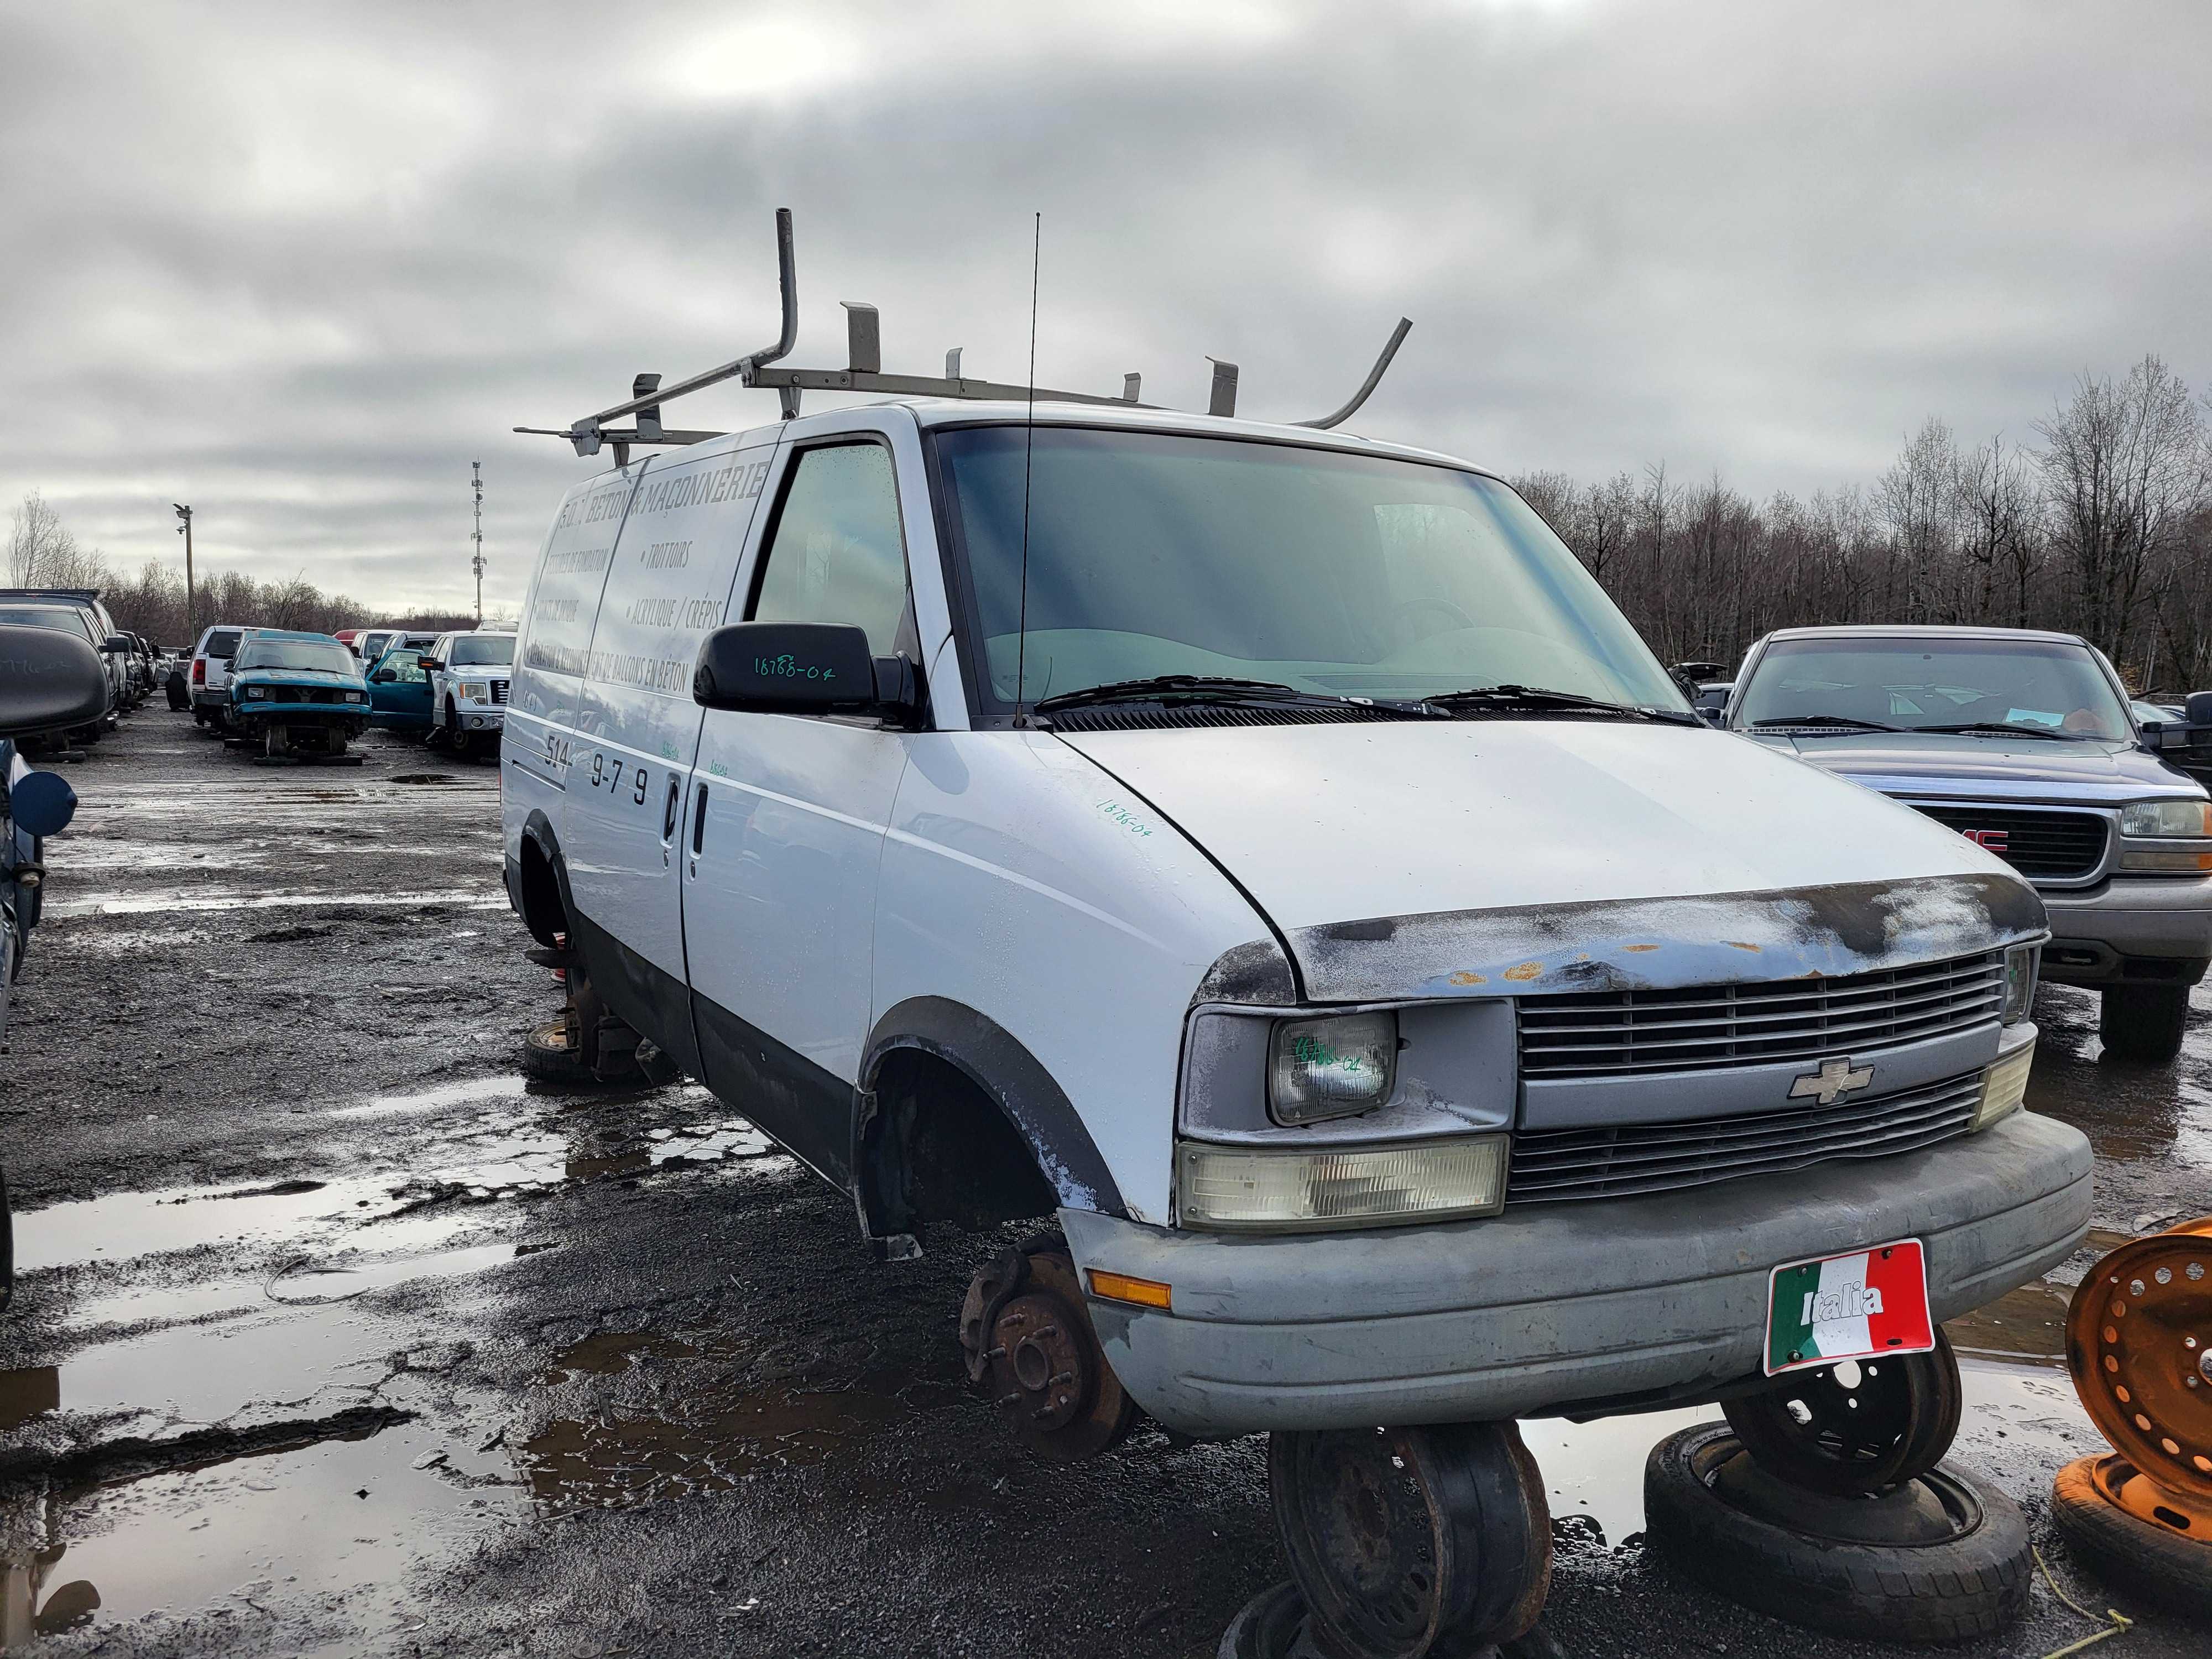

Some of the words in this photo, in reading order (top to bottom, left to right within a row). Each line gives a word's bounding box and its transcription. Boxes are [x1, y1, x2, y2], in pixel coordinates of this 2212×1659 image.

[585, 487, 634, 523] BÉTON
[630, 486, 644, 517] &
[640, 461, 770, 518] MAÇONNERIE
[646, 540, 693, 570] TROTTOIRS
[631, 599, 677, 628] ACRYLIQUE
[686, 592, 722, 630] CRÉPIS
[612, 655, 645, 685] BALCONS
[645, 659, 658, 687] EN
[658, 653, 688, 692] BÉTON
[1800, 1280, 1884, 1326] Italia
